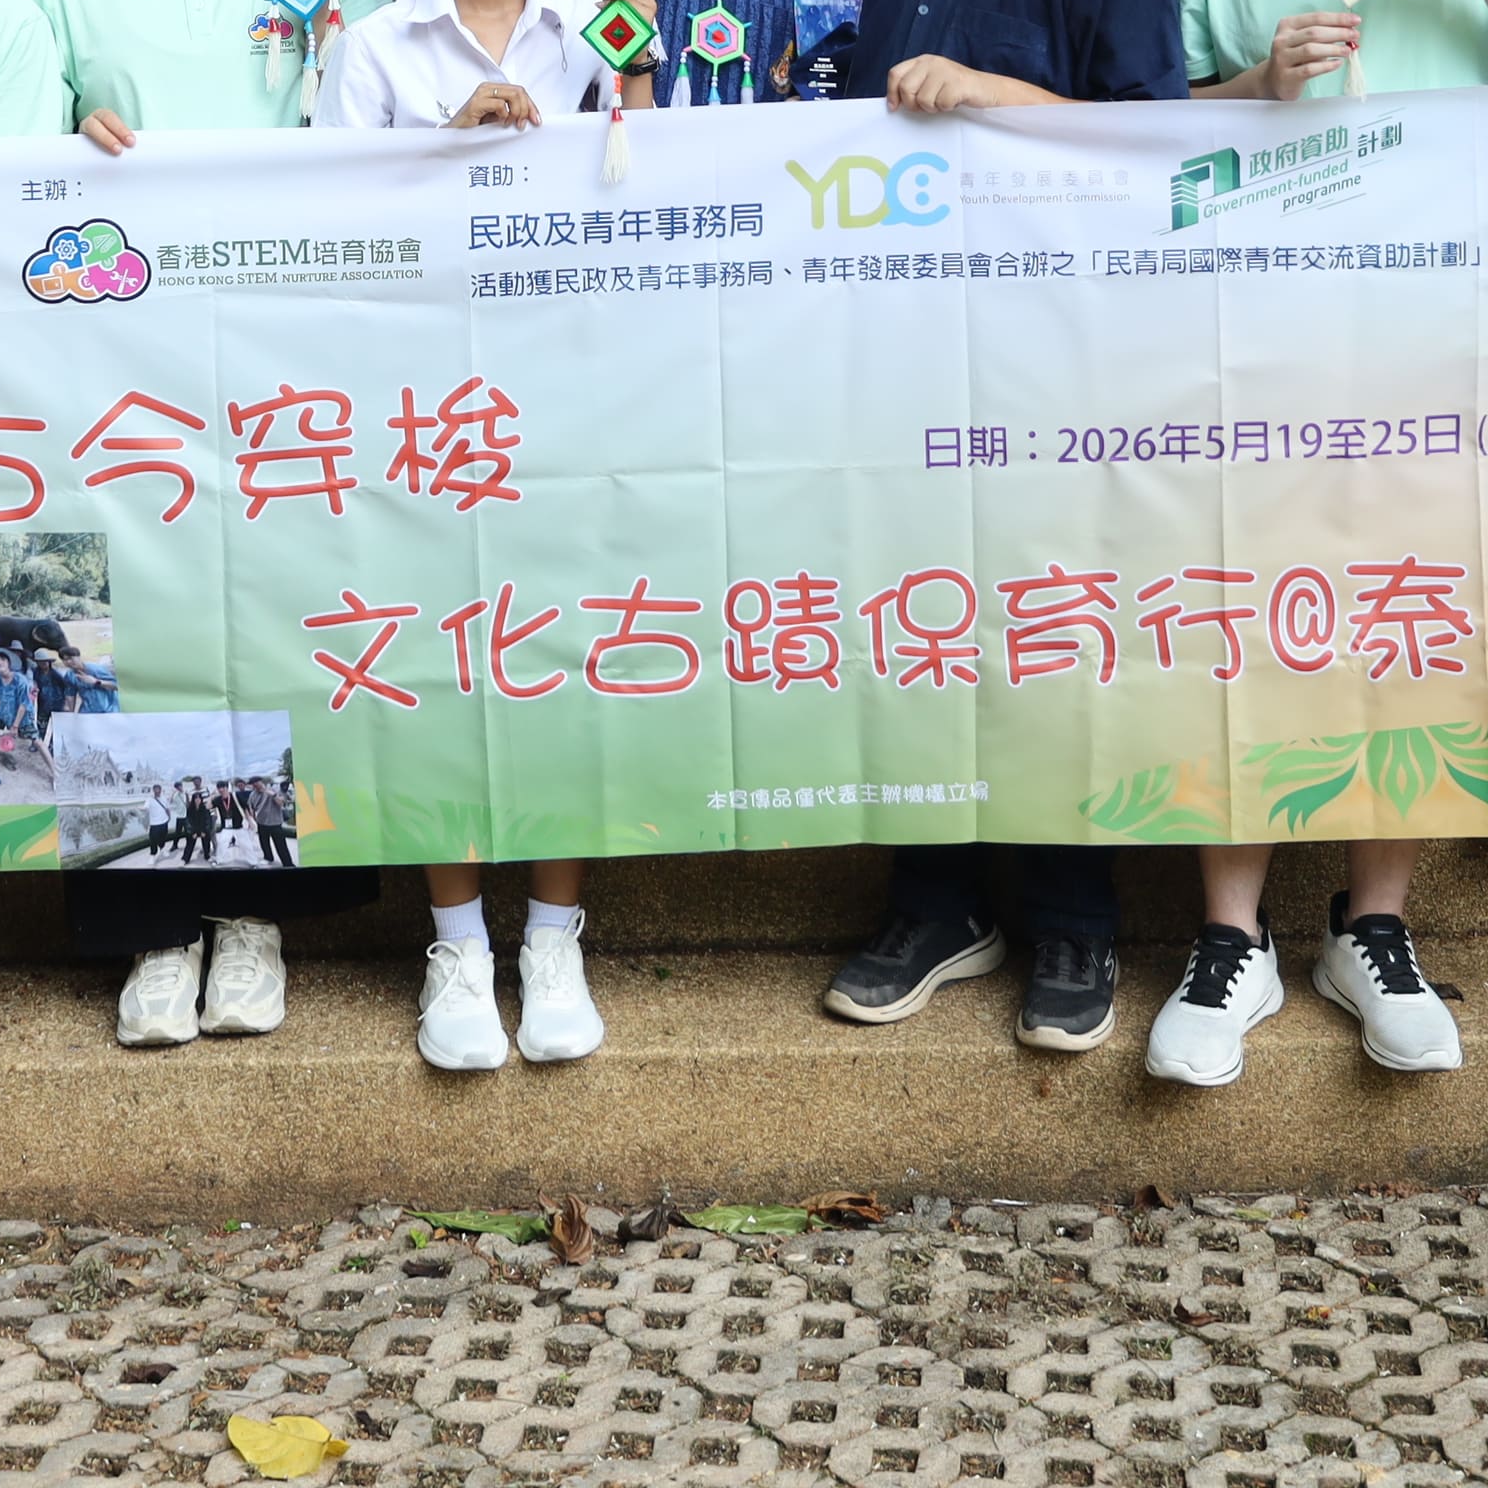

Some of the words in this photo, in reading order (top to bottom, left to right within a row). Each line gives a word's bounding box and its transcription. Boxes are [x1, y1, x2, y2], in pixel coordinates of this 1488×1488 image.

[1249, 125, 1348, 180] 政府資助
[1357, 122, 1402, 158] 計劃
[468, 164, 529, 188] 資助：
[785, 151, 950, 229] YDC
[1203, 159, 1348, 219] Government-funded
[1283, 175, 1361, 212] programme
[960, 194, 989, 205] Youth
[993, 193, 1062, 205] Development
[1066, 192, 1130, 203] Commission
[468, 203, 763, 250] 民政及青年事務局
[157, 237, 421, 270] 香港STEM培育協會
[158, 276, 195, 286] HONG
[198, 275, 234, 285] KONG
[237, 272, 277, 284] STEM
[282, 272, 337, 282] NURTURE
[341, 269, 423, 281] ASSOCIATION
[924, 414, 1462, 469] 日期：2026年5月19至25日
